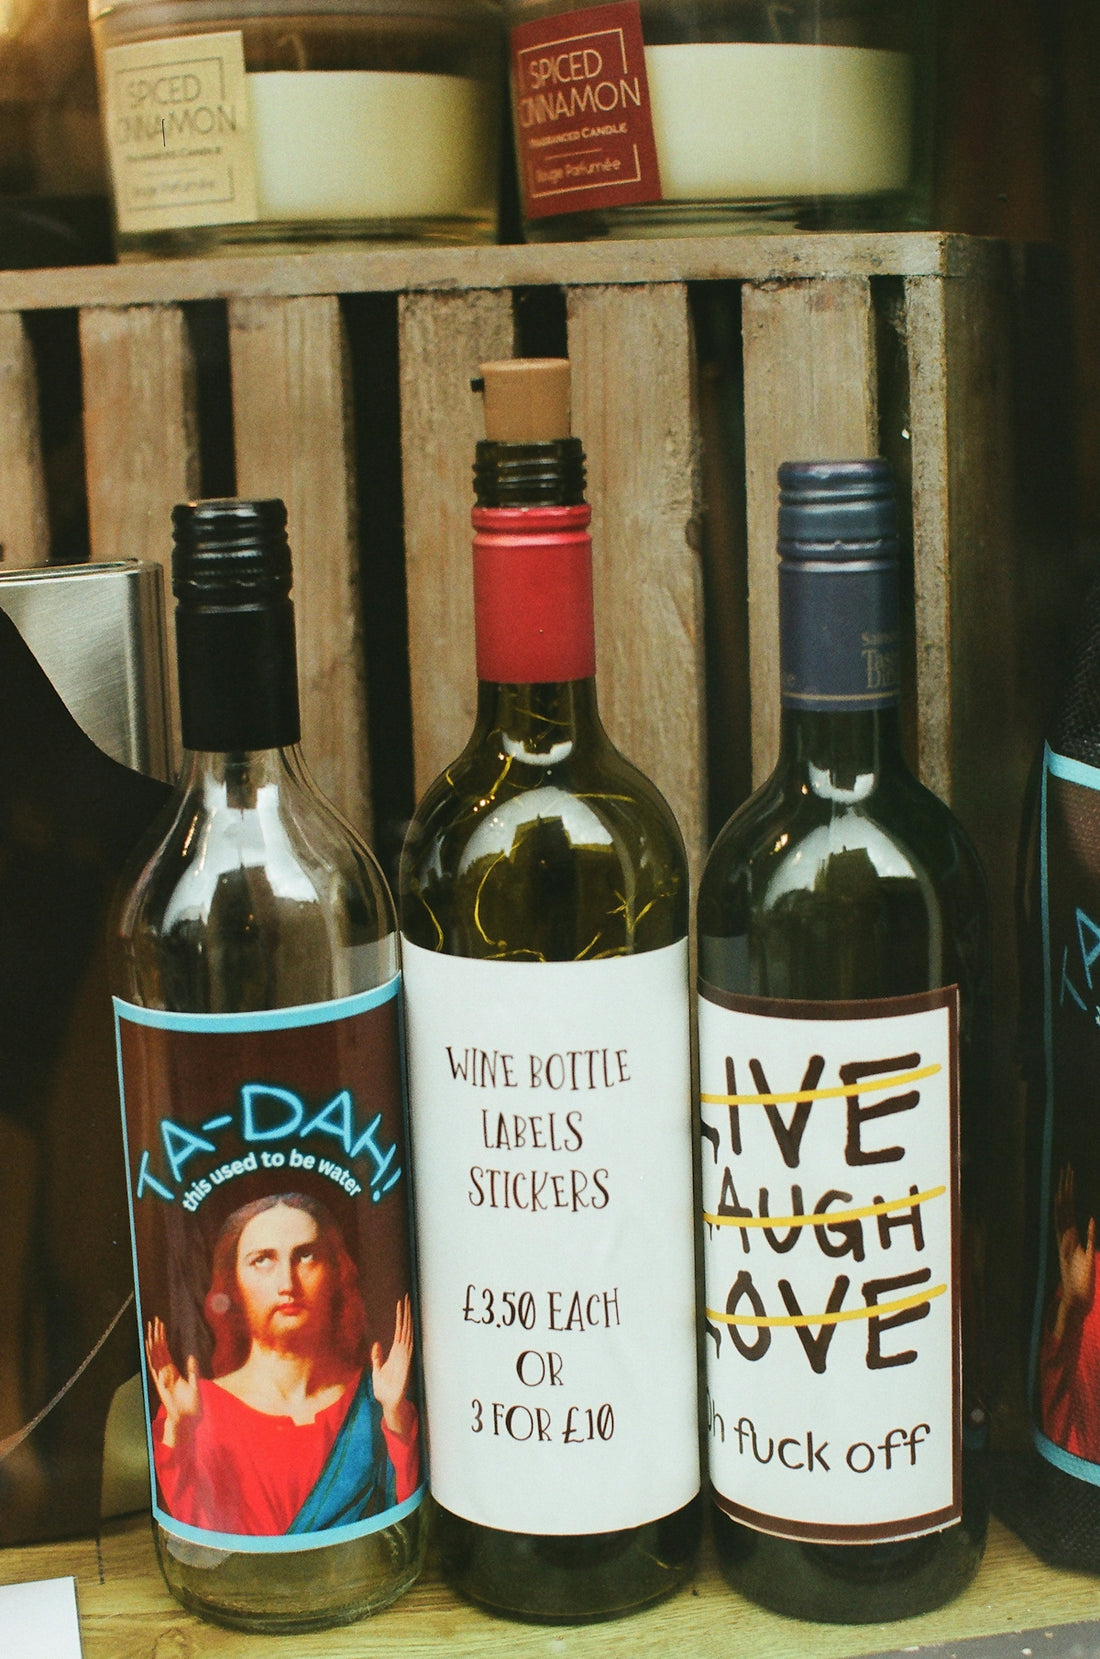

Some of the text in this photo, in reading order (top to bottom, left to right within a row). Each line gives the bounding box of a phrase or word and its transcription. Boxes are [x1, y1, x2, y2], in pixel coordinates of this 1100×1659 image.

[528, 49, 603, 90] SPICED
[445, 1046, 632, 1091] WINE BOTTLE
[482, 1108, 583, 1152] LABELS
[182, 1148, 362, 1212] this used to be water
[468, 1165, 610, 1213] STICKERS
[702, 1165, 926, 1263] AUGH
[462, 1283, 621, 1332] £3.50 EACH
[515, 1349, 565, 1388] OR
[470, 1397, 615, 1444] 3 FOR £10
[733, 1416, 831, 1473] fuck
[845, 1422, 931, 1474] off
